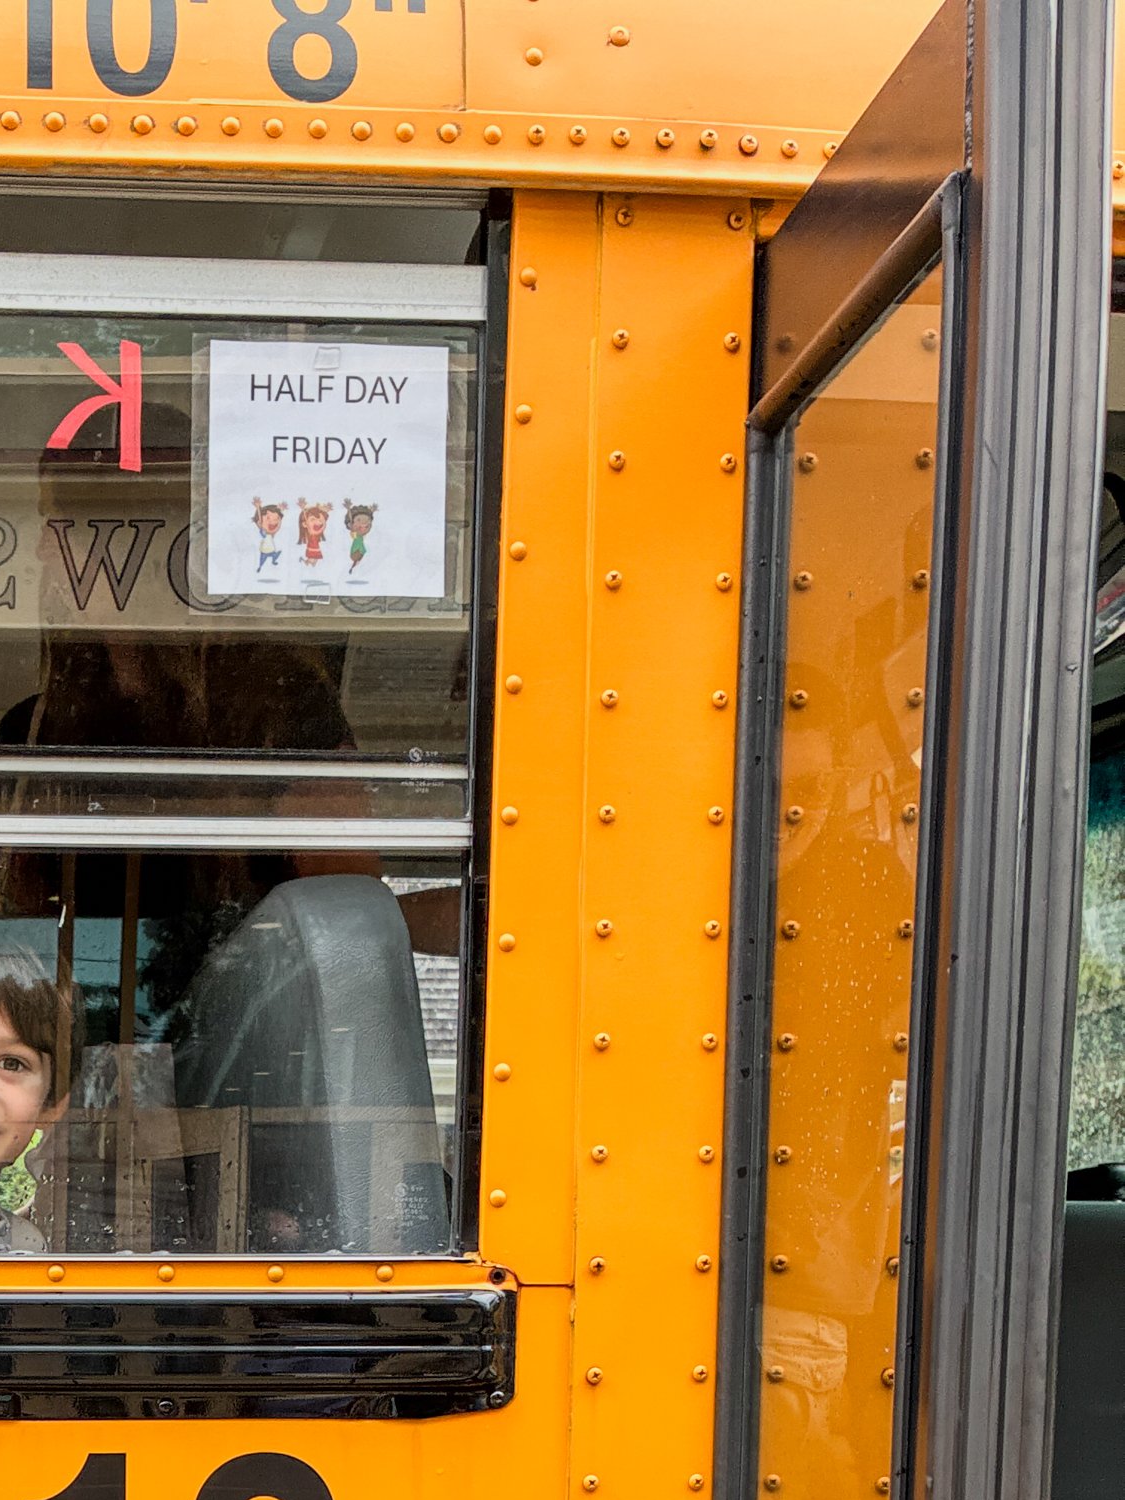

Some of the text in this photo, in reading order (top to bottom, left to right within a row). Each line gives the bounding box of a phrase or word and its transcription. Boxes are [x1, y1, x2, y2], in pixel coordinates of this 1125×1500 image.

[25, 0, 208, 97] 10
[266, 0, 426, 103] 8
[250, 373, 408, 405] HALF DAY
[272, 435, 387, 465] FRIDAY
